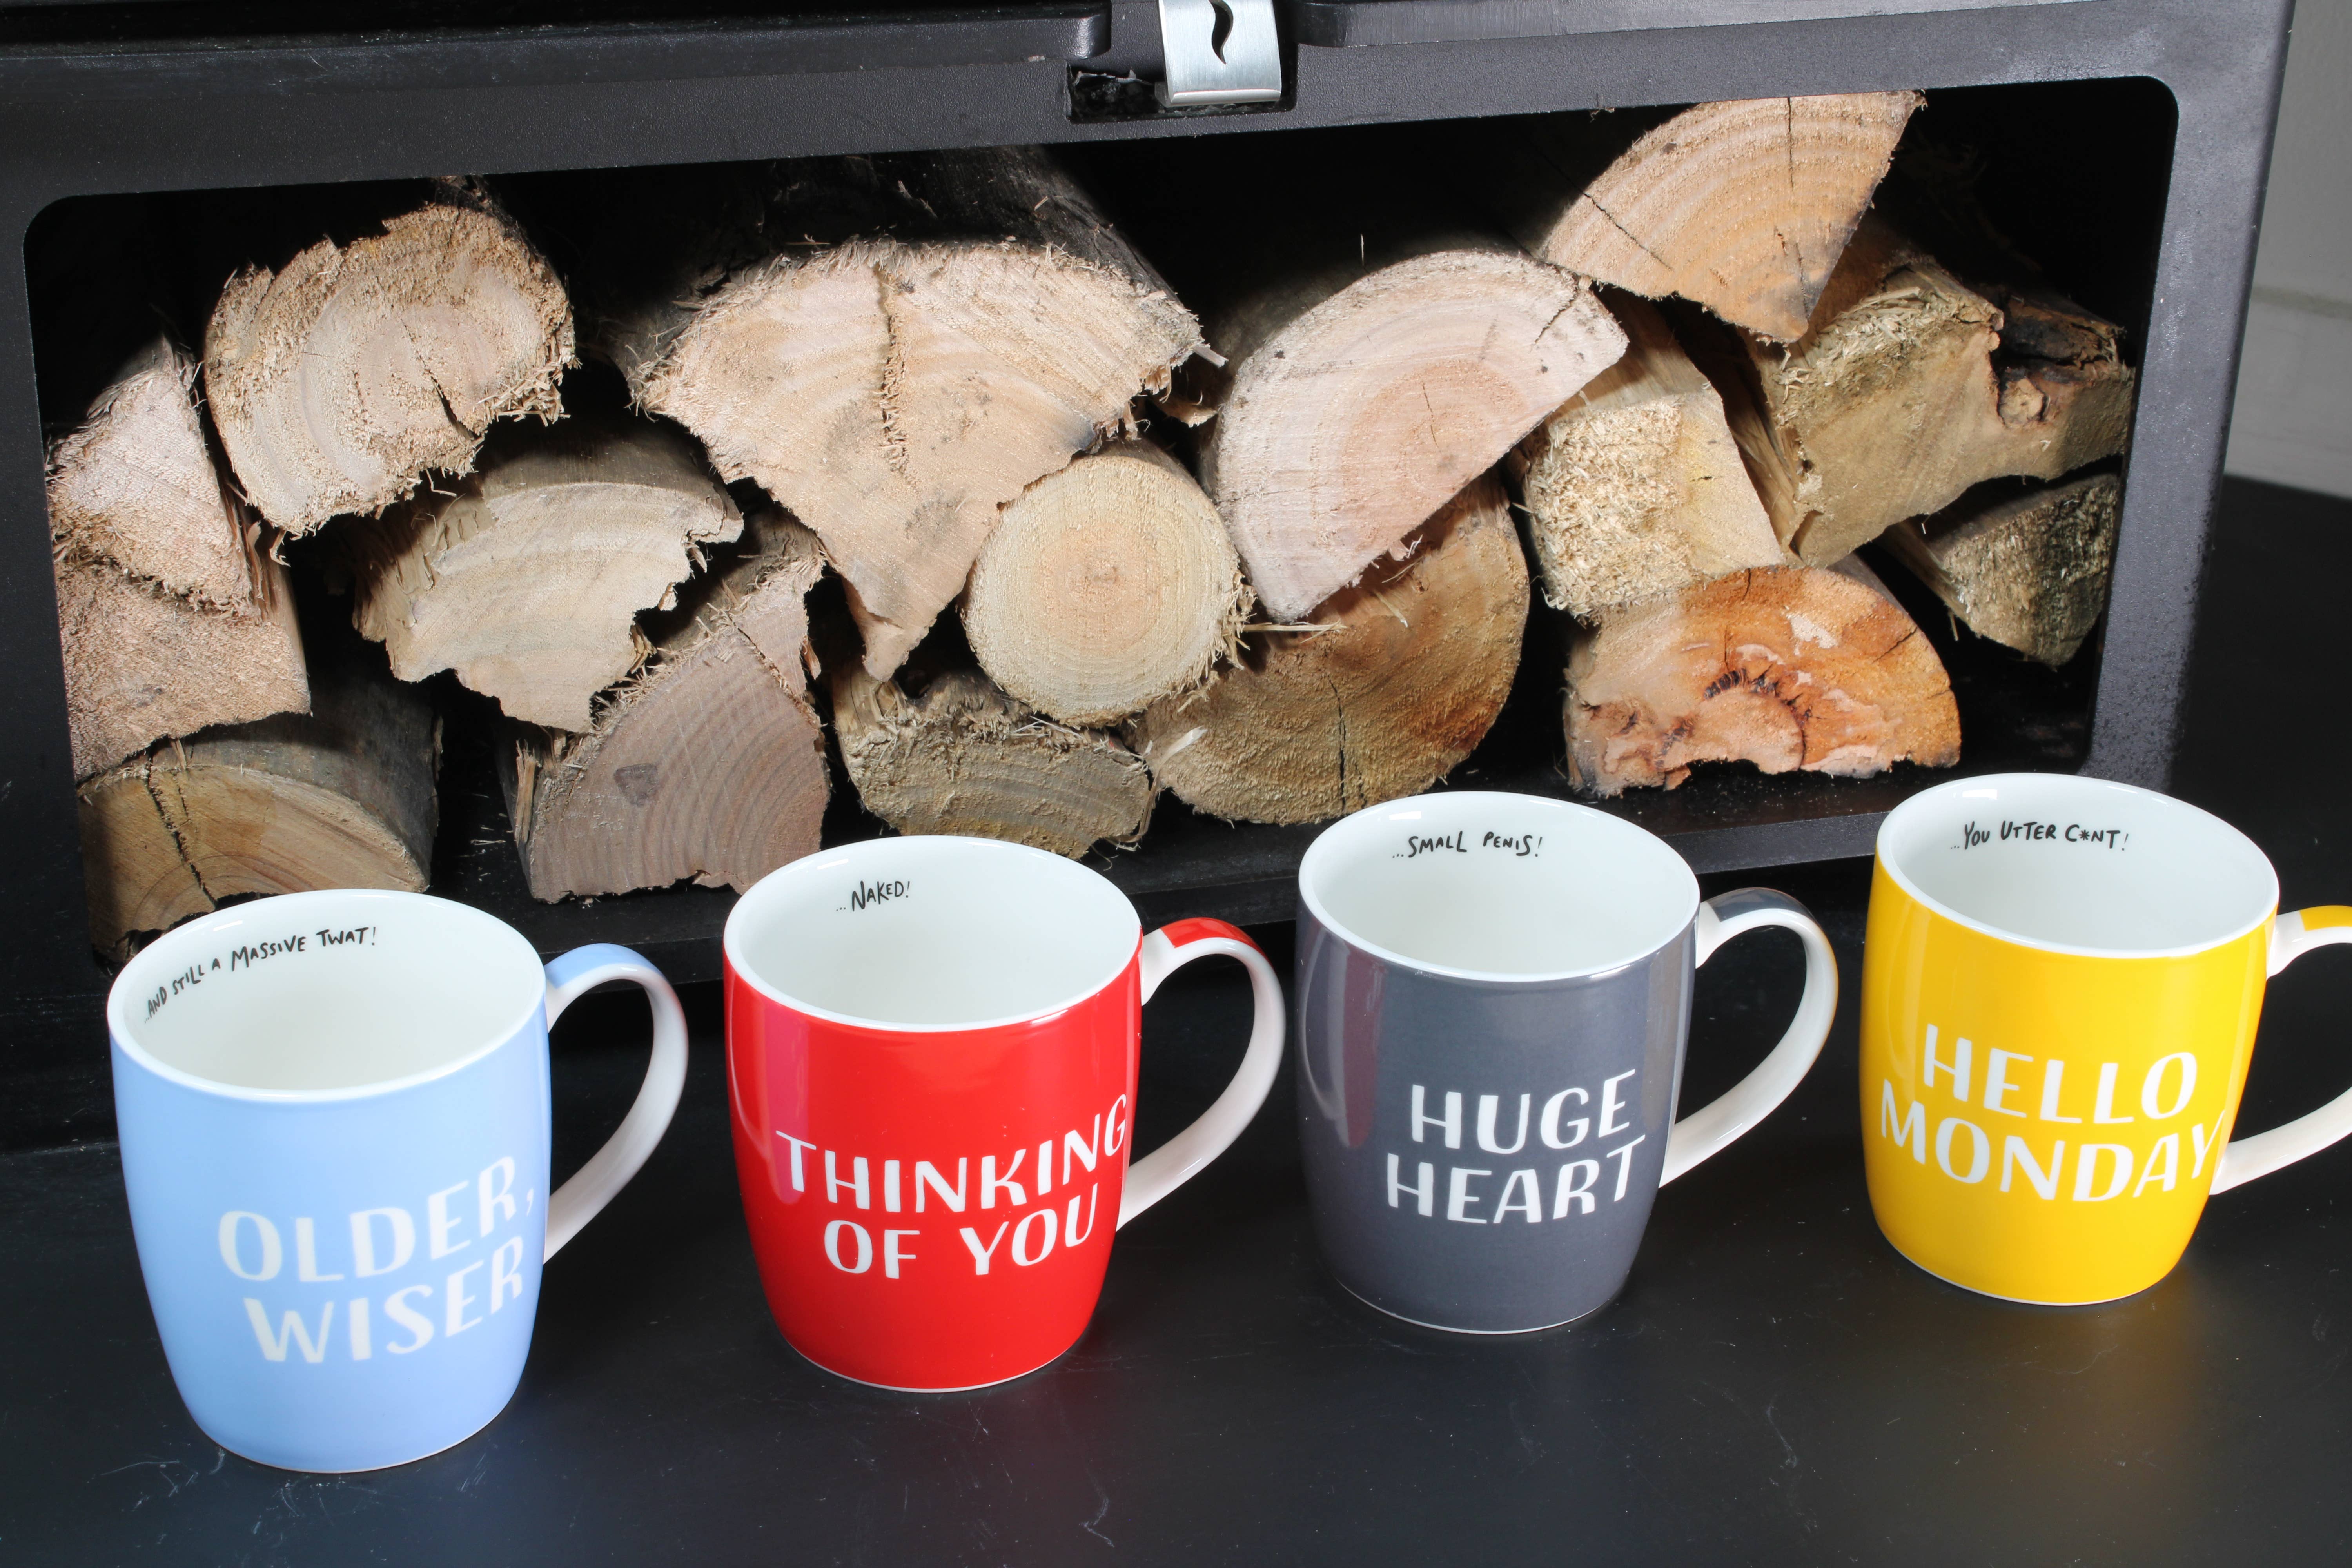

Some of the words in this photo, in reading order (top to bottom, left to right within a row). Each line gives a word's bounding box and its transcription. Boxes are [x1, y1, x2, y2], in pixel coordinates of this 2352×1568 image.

[1483, 831, 1543, 857] PENIS!
[2000, 820, 2056, 841] UTTER
[172, 965, 205, 995] STILL
[212, 958, 221, 971] A
[232, 935, 307, 971] MASSIVE
[316, 926, 376, 946] TWAT!
[1411, 1068, 1636, 1154] HUGE
[1923, 1023, 2197, 1124] HELLO
[775, 1093, 1127, 1213] THINKING
[1387, 1134, 1646, 1224] HEART
[1881, 1078, 2225, 1201] MONDAY
[218, 1155, 535, 1282] OLDER,
[824, 1220, 920, 1279] OF
[959, 1182, 1098, 1276] YOU
[243, 1235, 524, 1364] WISER
